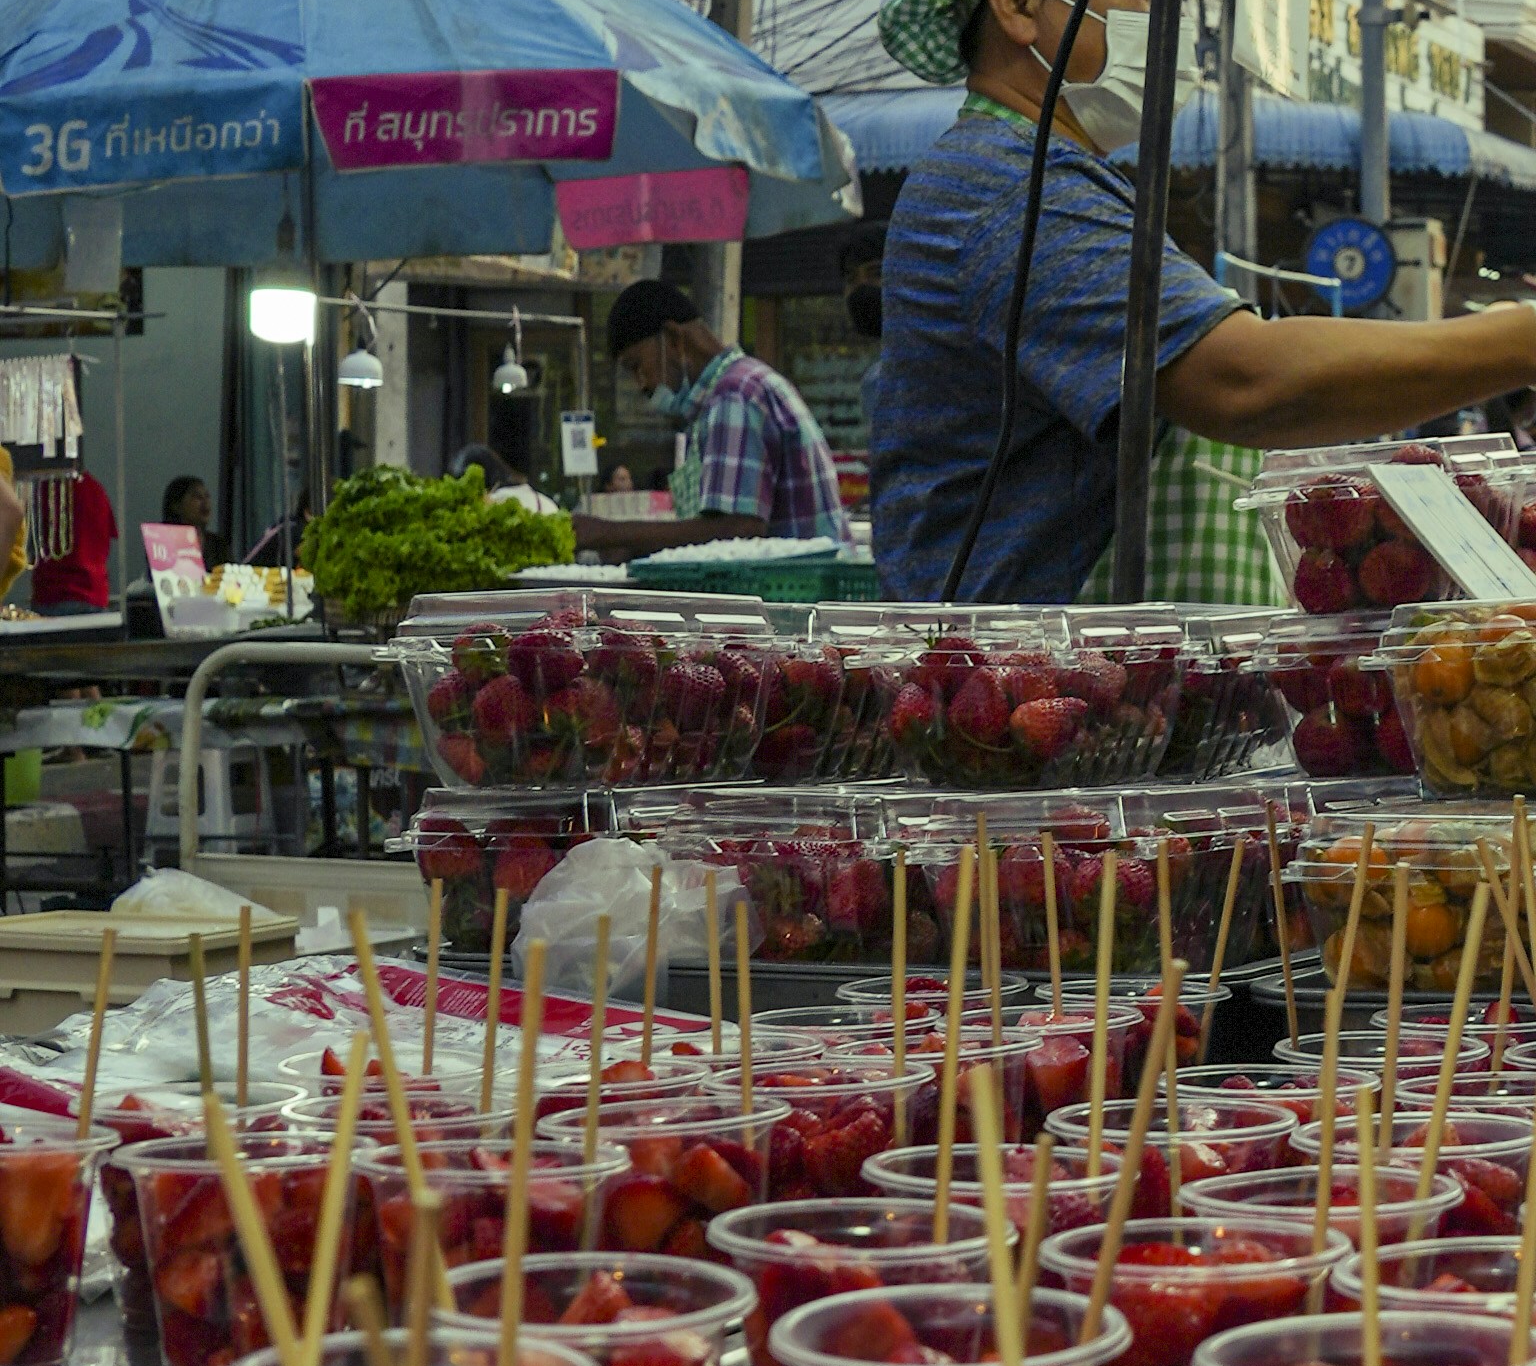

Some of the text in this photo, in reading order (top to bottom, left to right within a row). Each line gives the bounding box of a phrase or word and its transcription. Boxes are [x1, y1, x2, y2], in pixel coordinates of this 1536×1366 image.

[21, 109, 281, 177] 3G ที่เหนือกว่า
[344, 101, 599, 152] ที่ สมุทรปราการ
